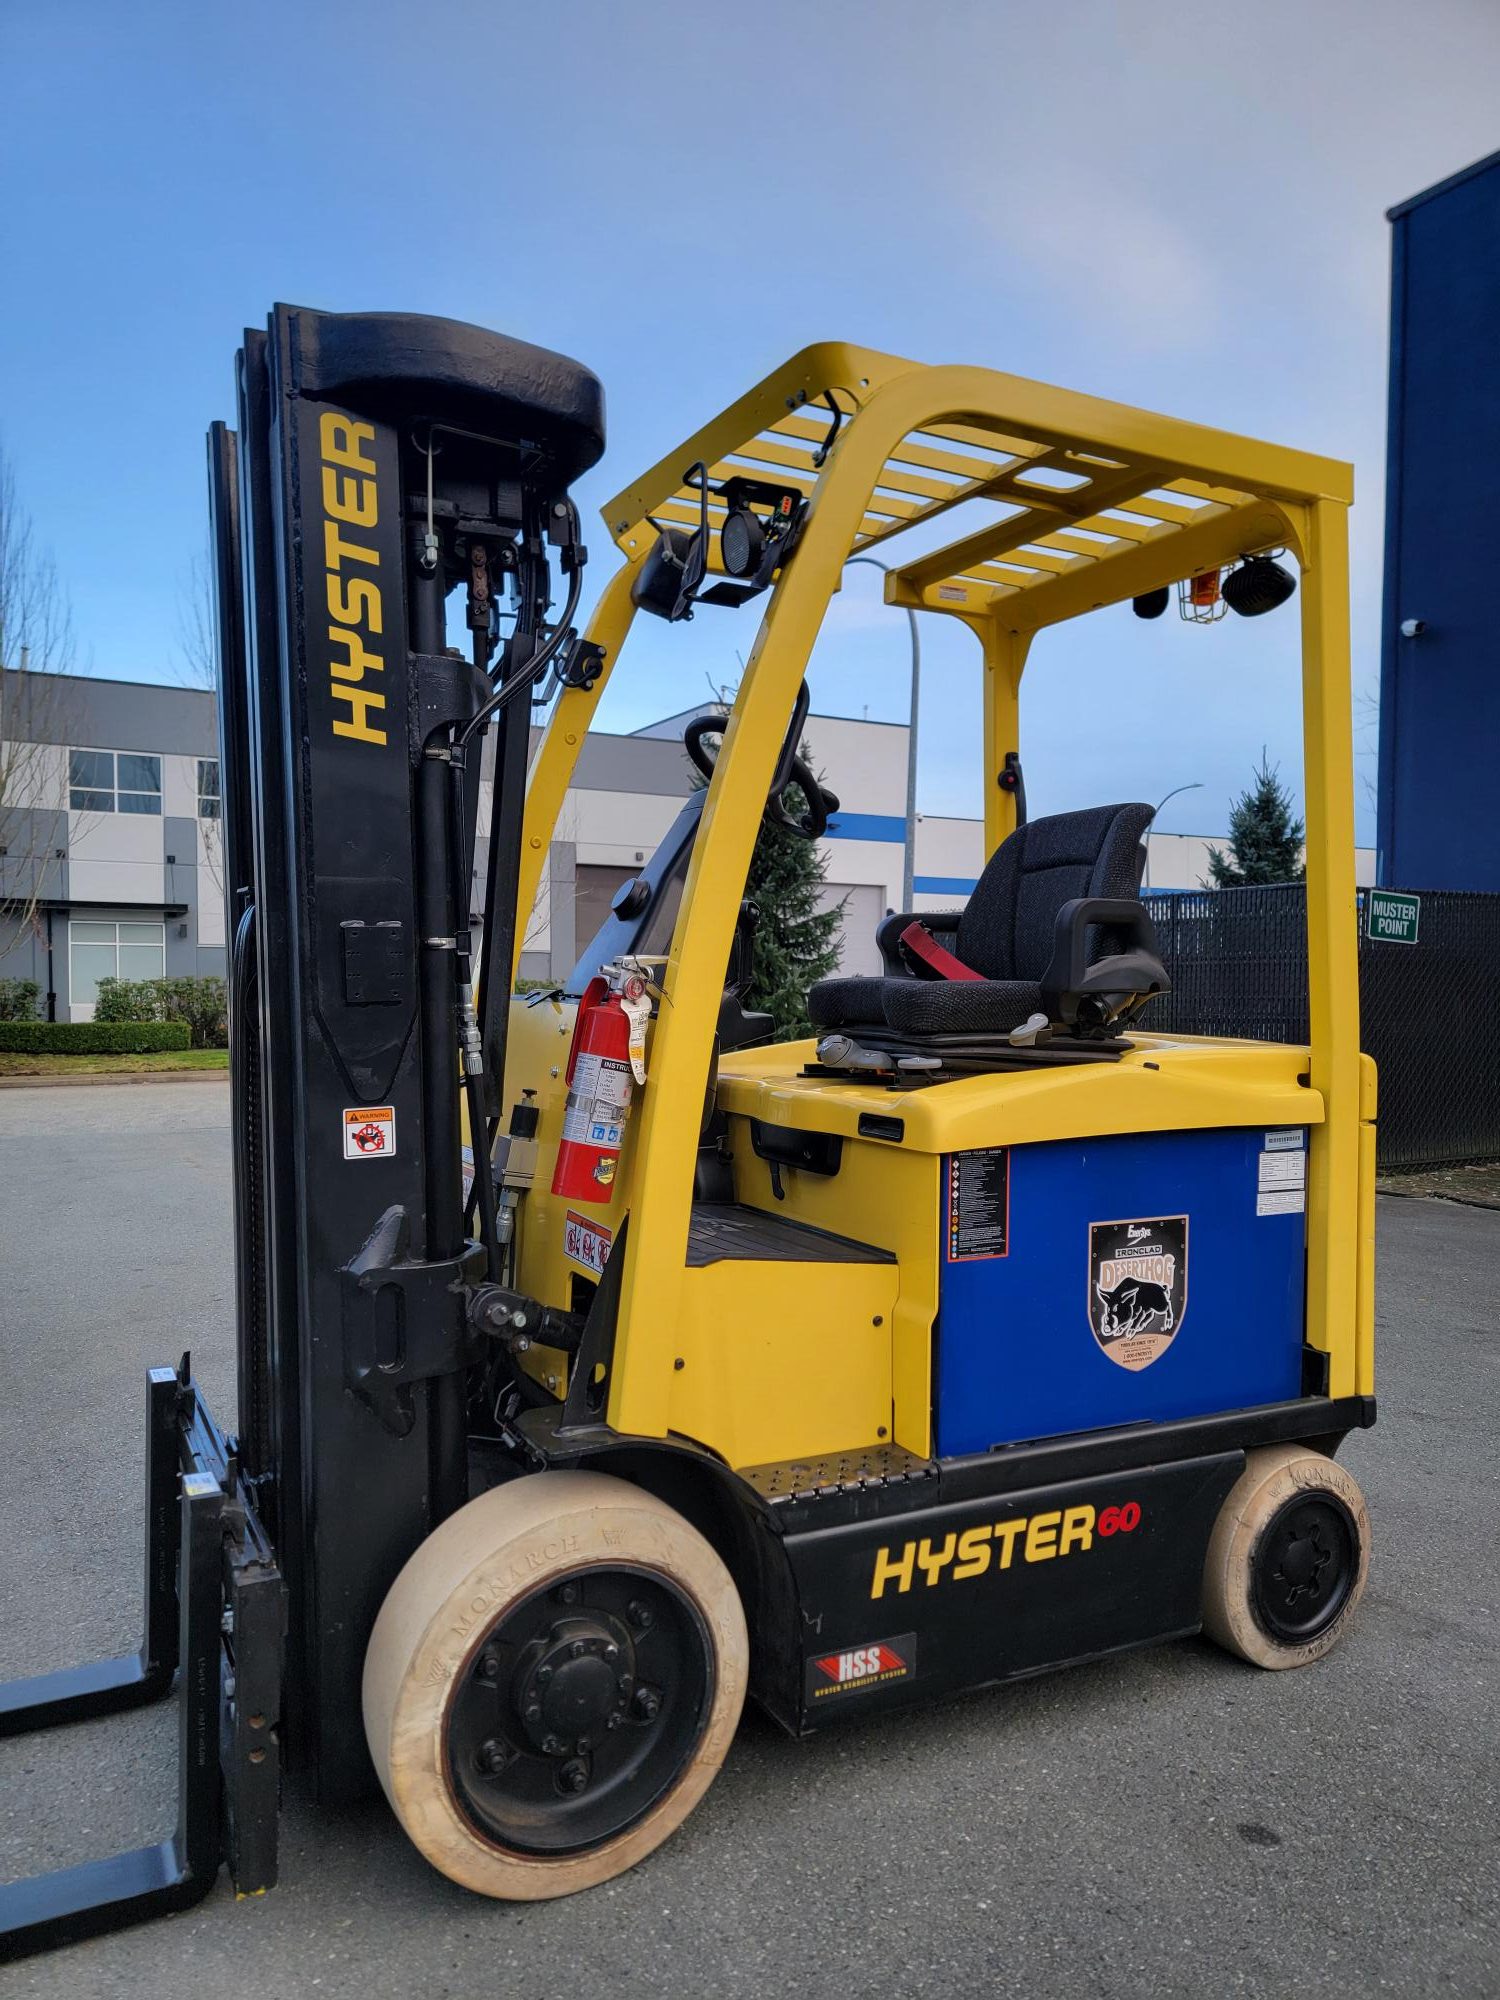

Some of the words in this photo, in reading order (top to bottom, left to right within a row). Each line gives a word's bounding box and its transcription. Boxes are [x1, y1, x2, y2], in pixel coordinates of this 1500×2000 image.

[319, 411, 387, 746] HYSTER
[1373, 900, 1416, 920] MUSTER
[1378, 918, 1410, 936] POINT
[1117, 1246, 1161, 1257] IRONCLAD
[1101, 1255, 1175, 1292] DESERTHOG
[870, 1504, 1096, 1600] HYSTER
[1098, 1502, 1141, 1537] 60
[451, 1535, 580, 1638] MONARCH
[838, 1646, 881, 1682] HSS
